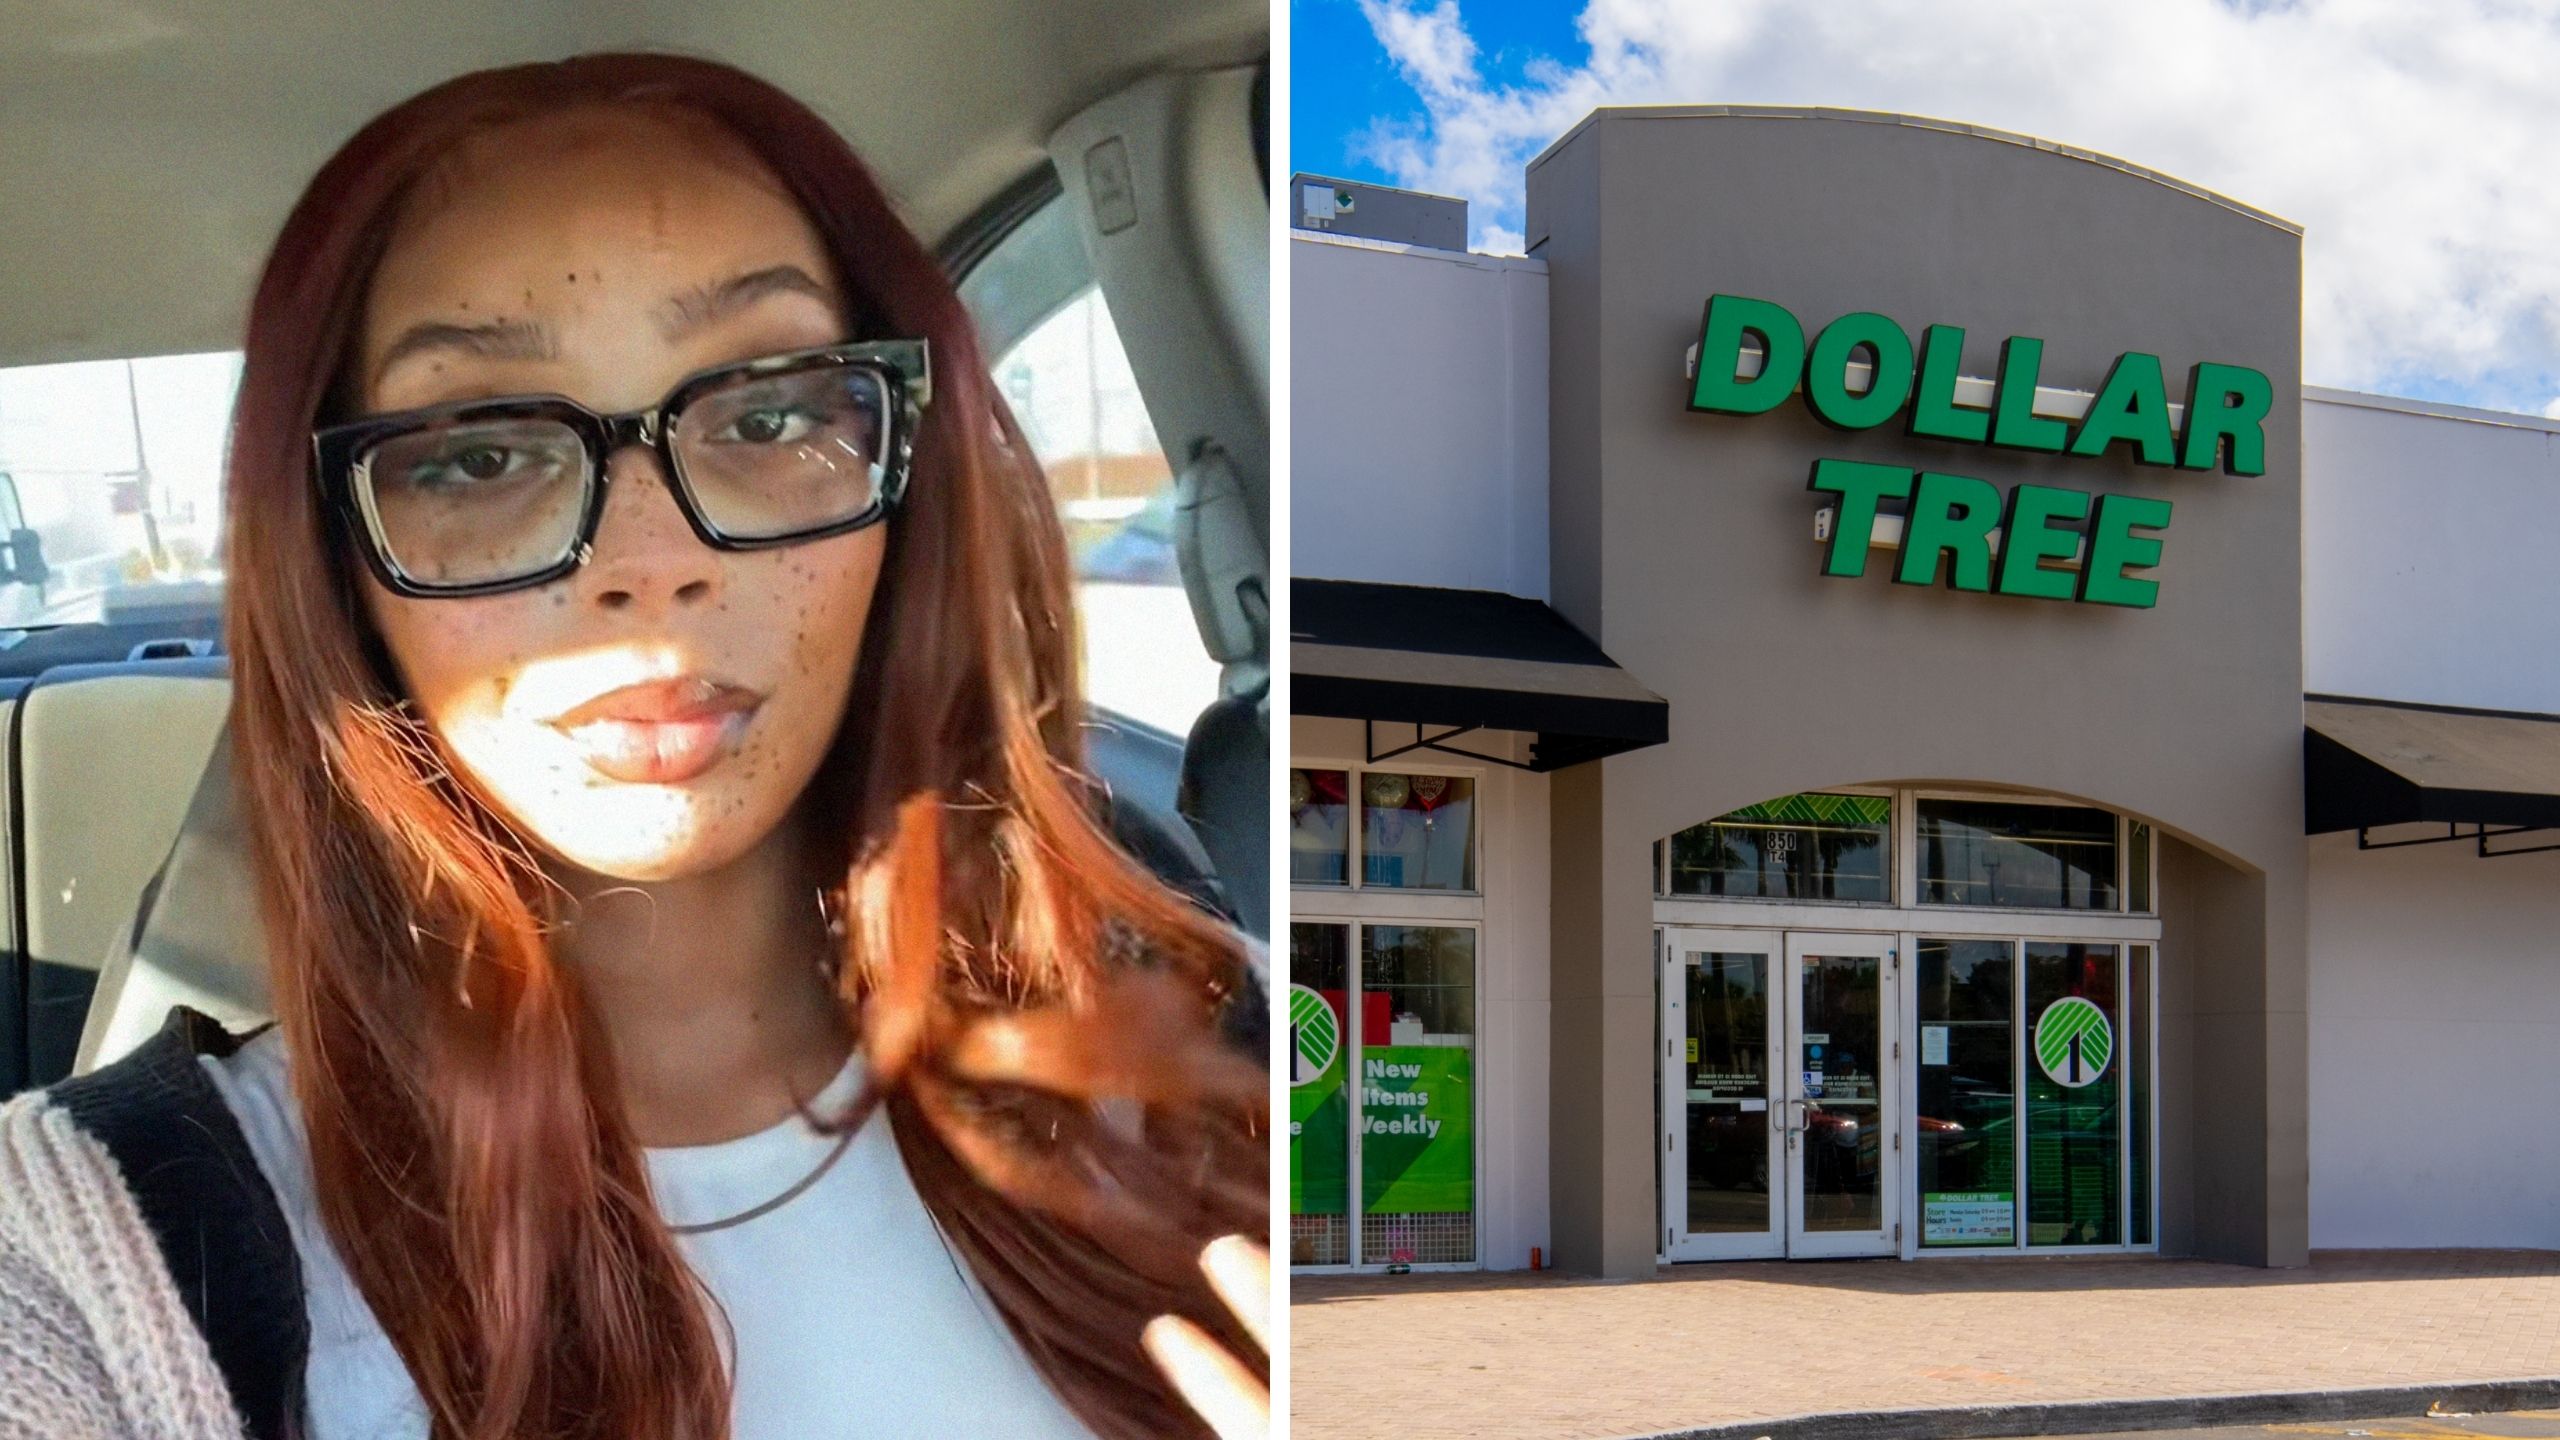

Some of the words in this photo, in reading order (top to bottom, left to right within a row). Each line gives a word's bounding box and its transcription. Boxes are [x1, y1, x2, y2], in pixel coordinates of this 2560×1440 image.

[1687, 294, 2273, 477] DOLLAR
[1807, 458, 2173, 608] TREE
[1769, 832, 1795, 849] 850
[1771, 851, 1785, 862] T4
[1366, 1059, 1421, 1078] New
[1362, 1087, 1429, 1106] Items
